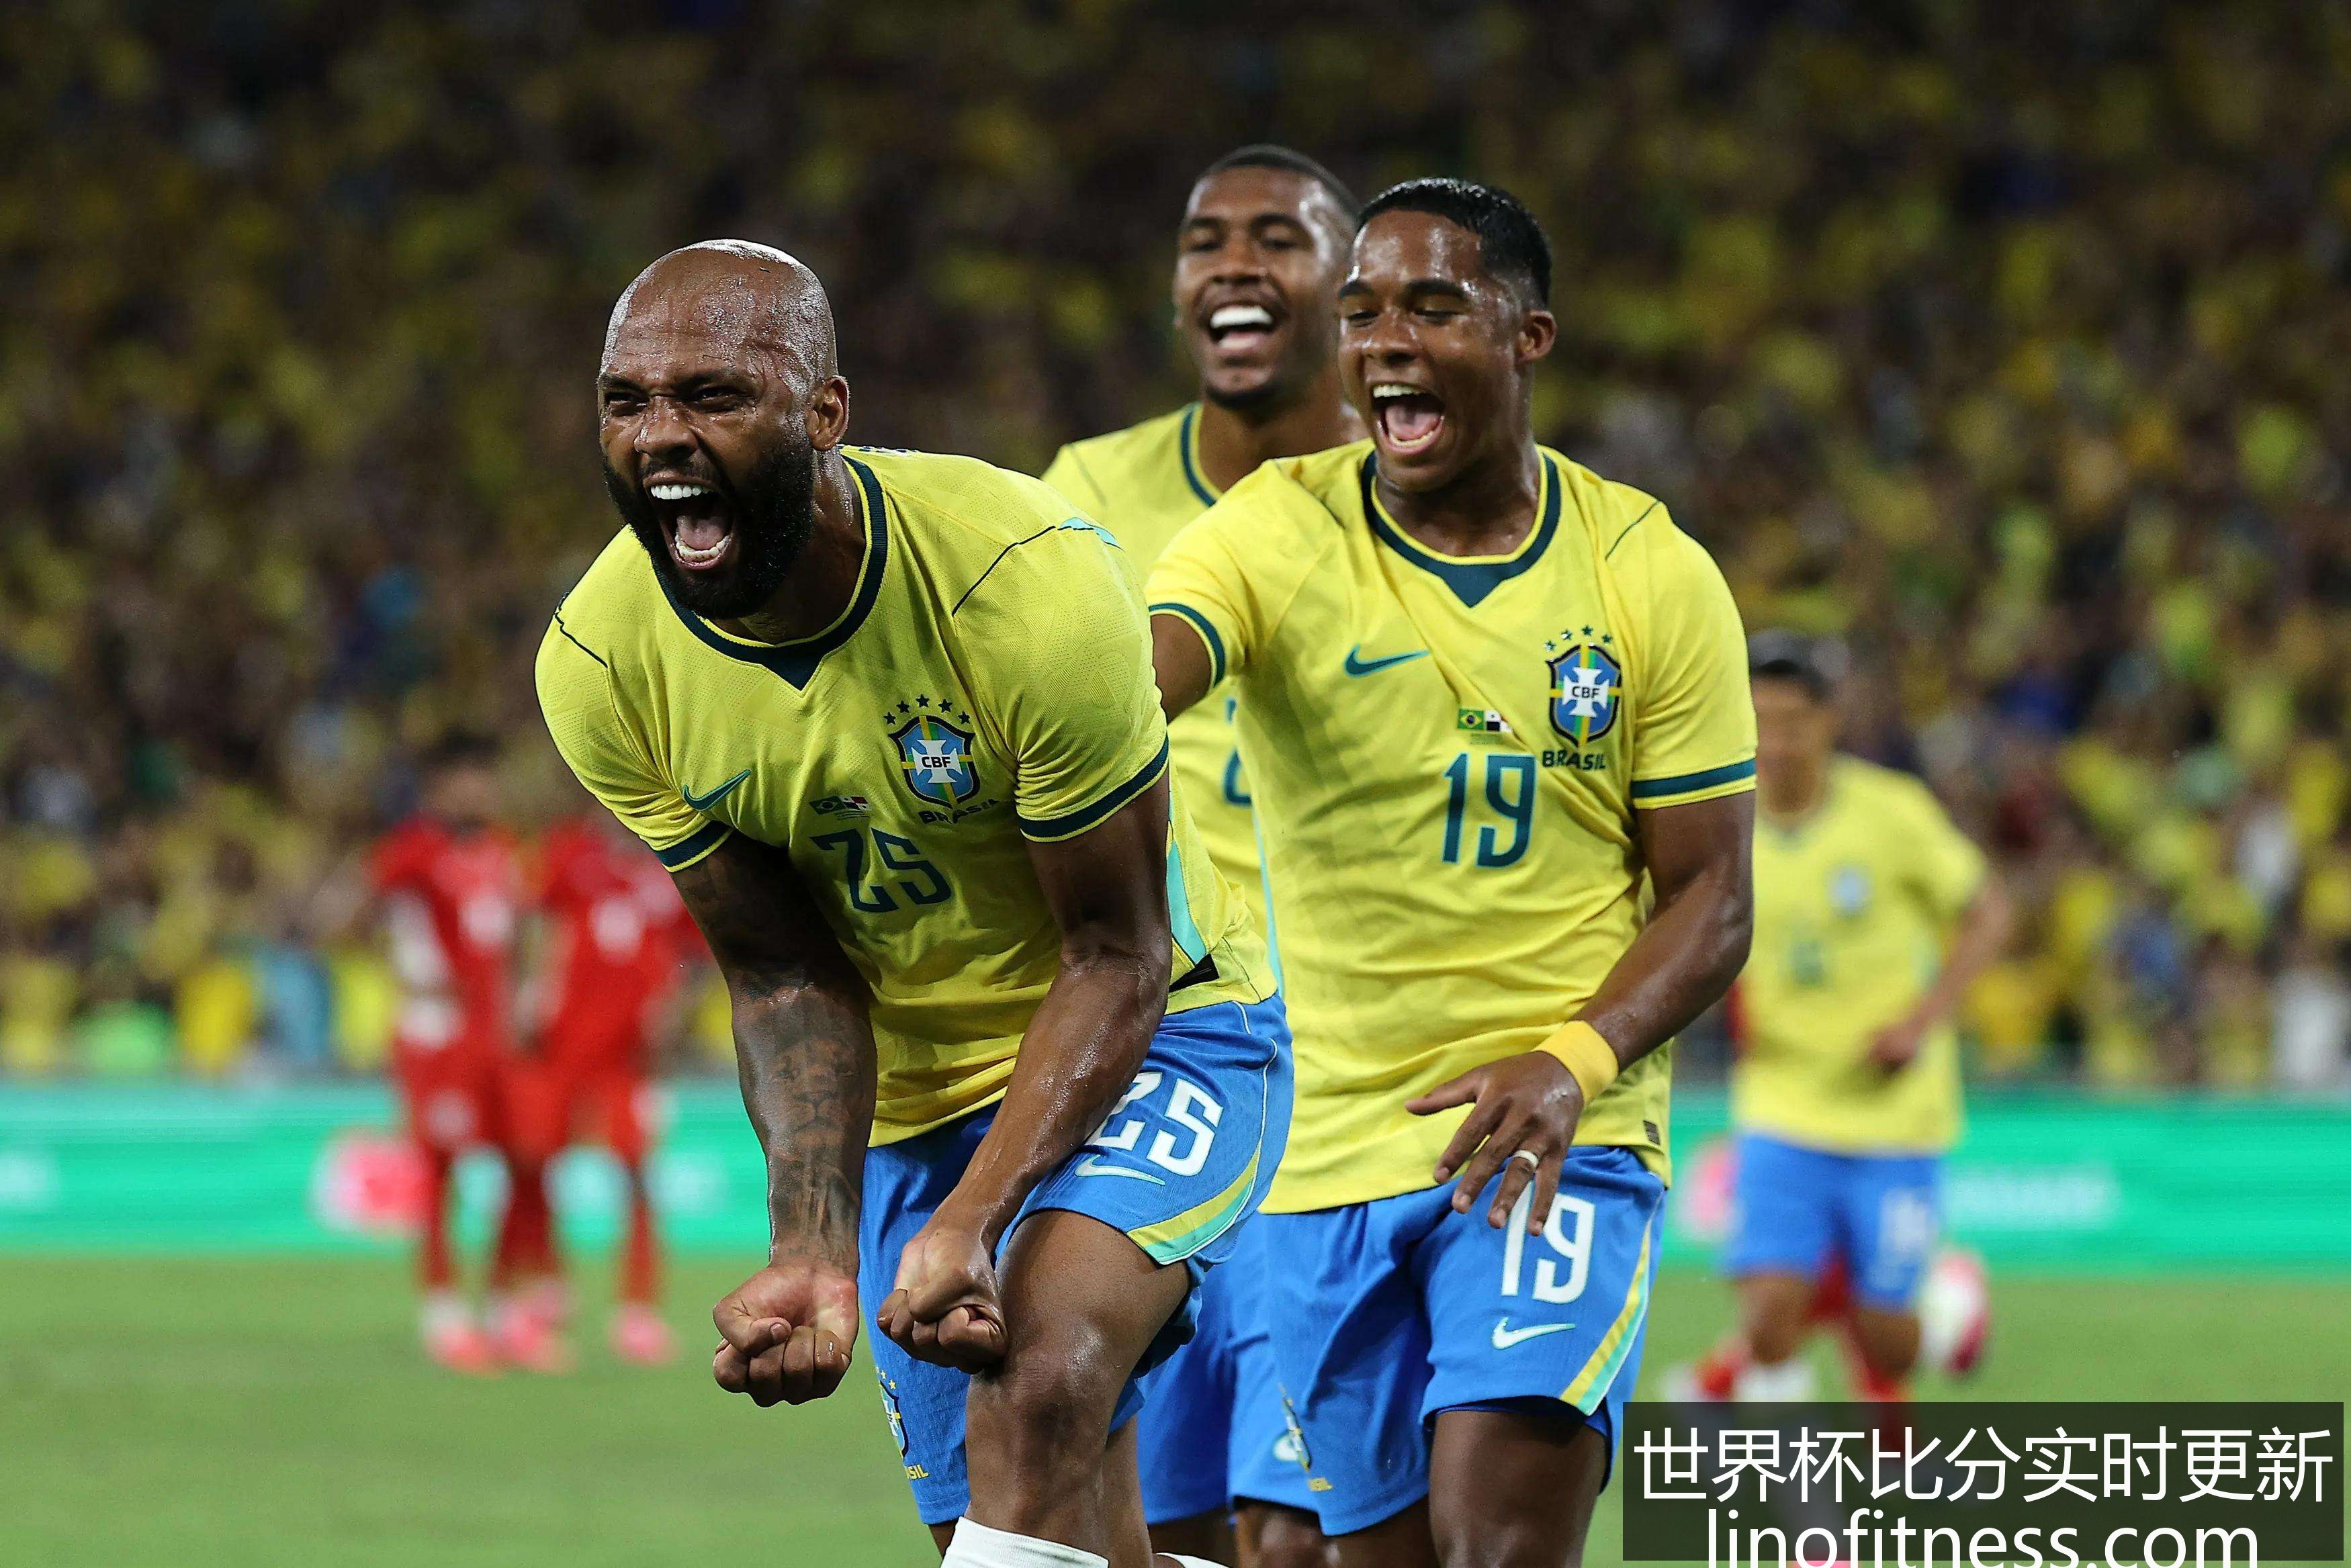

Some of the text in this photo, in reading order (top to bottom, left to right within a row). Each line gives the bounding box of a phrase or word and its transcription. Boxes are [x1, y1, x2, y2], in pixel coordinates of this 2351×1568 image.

[1572, 684, 1600, 698] CBF
[922, 755, 951, 768] CBF
[1542, 750, 1605, 770] BRASIL
[918, 798, 998, 824] BRASIL
[1443, 753, 1536, 867] 19
[810, 827, 952, 912] 25
[1083, 1071, 1224, 1177] 25
[1501, 1181, 1595, 1304] 19
